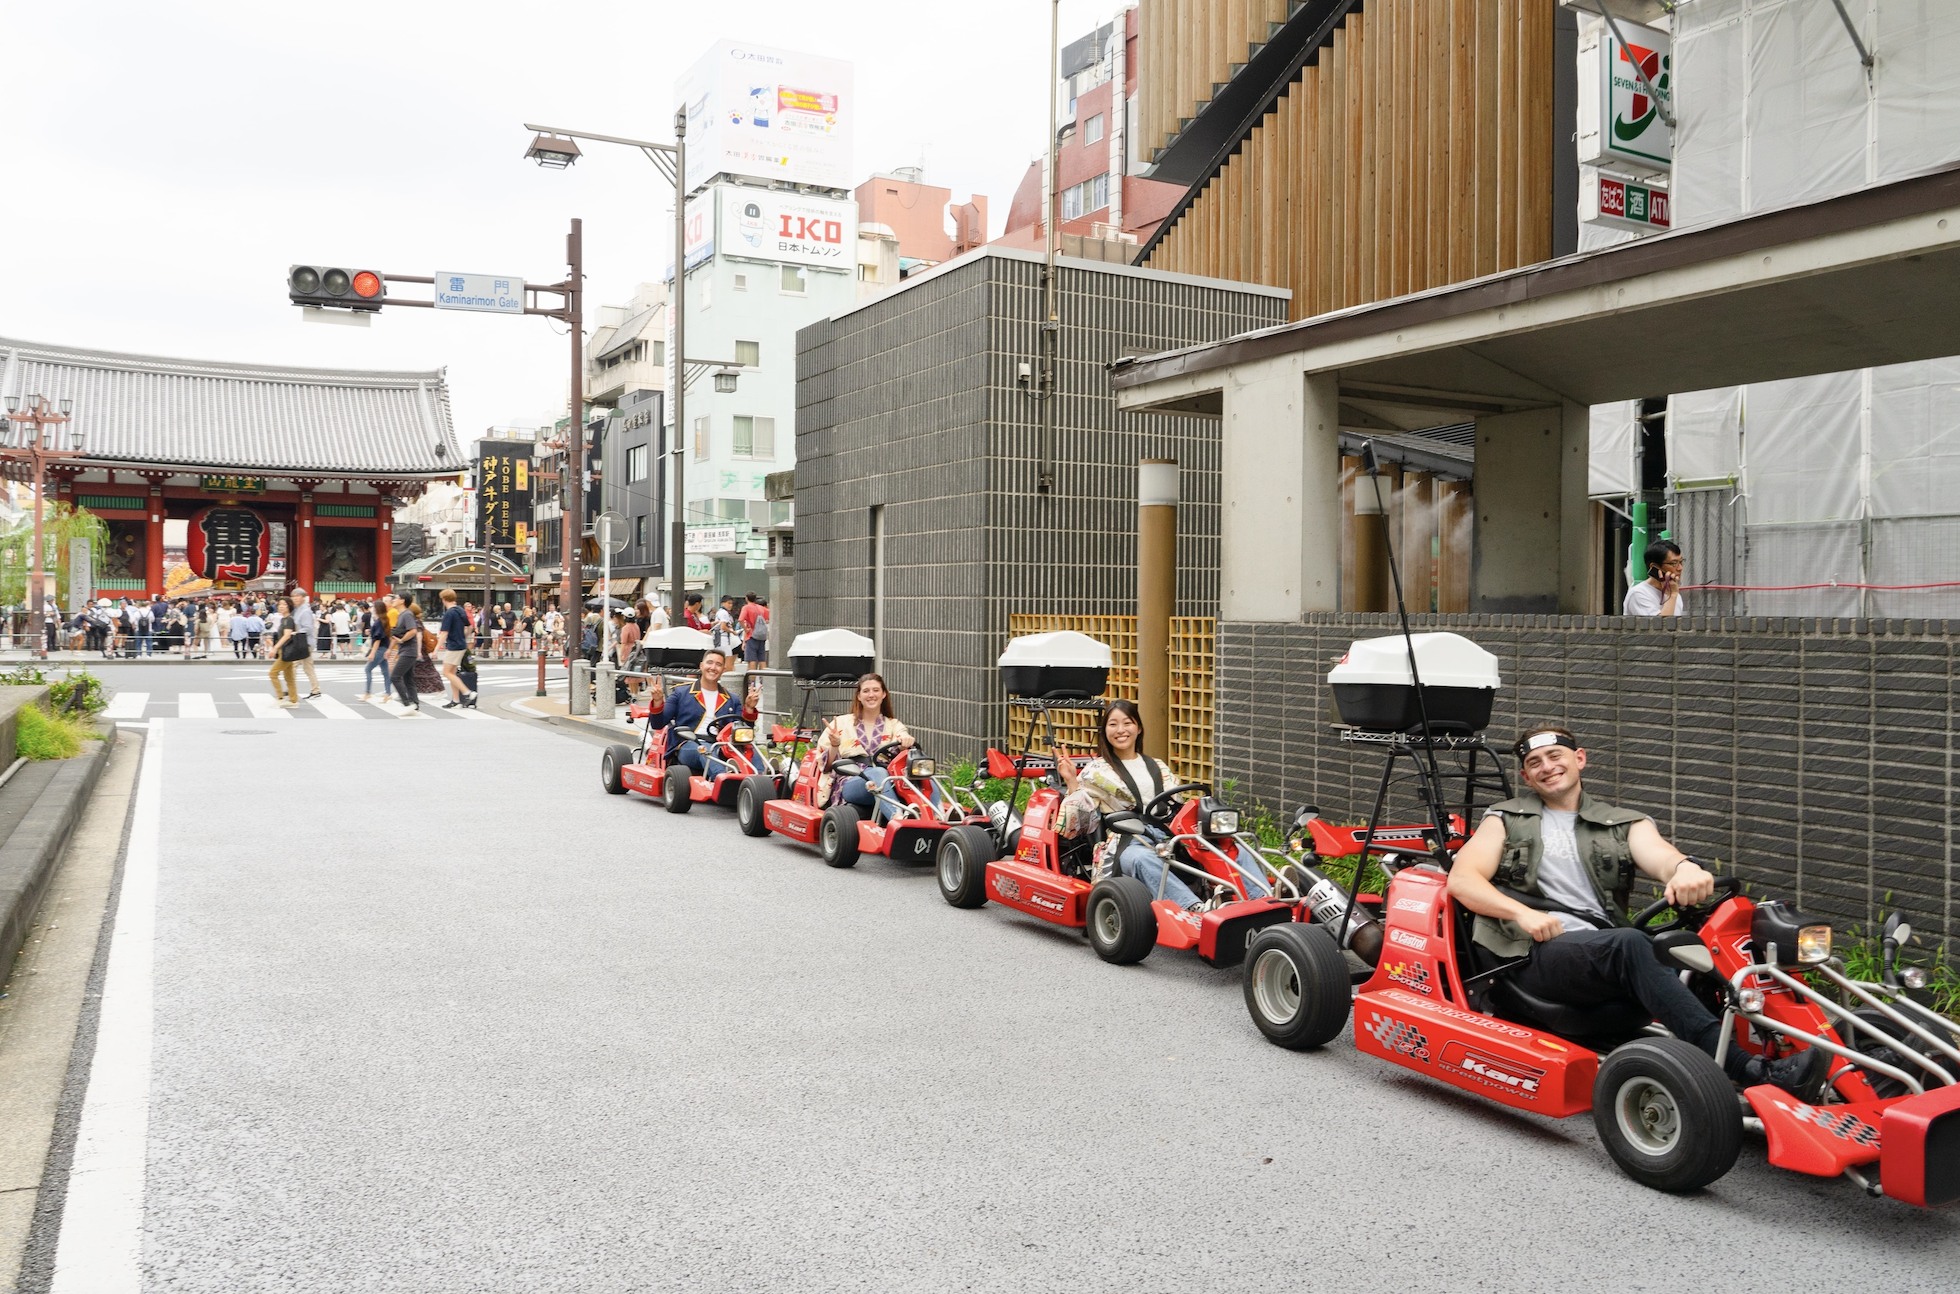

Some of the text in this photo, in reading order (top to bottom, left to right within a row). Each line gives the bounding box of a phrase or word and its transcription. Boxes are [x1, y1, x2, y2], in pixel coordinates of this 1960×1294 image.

[1601, 184, 1624, 210] たばこ
[1629, 190, 1645, 216] 酒
[779, 214, 842, 244] IKO
[778, 242, 842, 258] 日本トムソン
[439, 292, 519, 308] Kaminarimon Gate
[501, 457, 510, 538] KOBE BEEF
[200, 507, 264, 580] 雷門
[1030, 895, 1064, 912] Kart
[1398, 930, 1426, 950] Castrol
[1398, 1041, 1430, 1058] 50
[1438, 1063, 1538, 1100] streetpower
[1462, 1058, 1539, 1092] Kart
